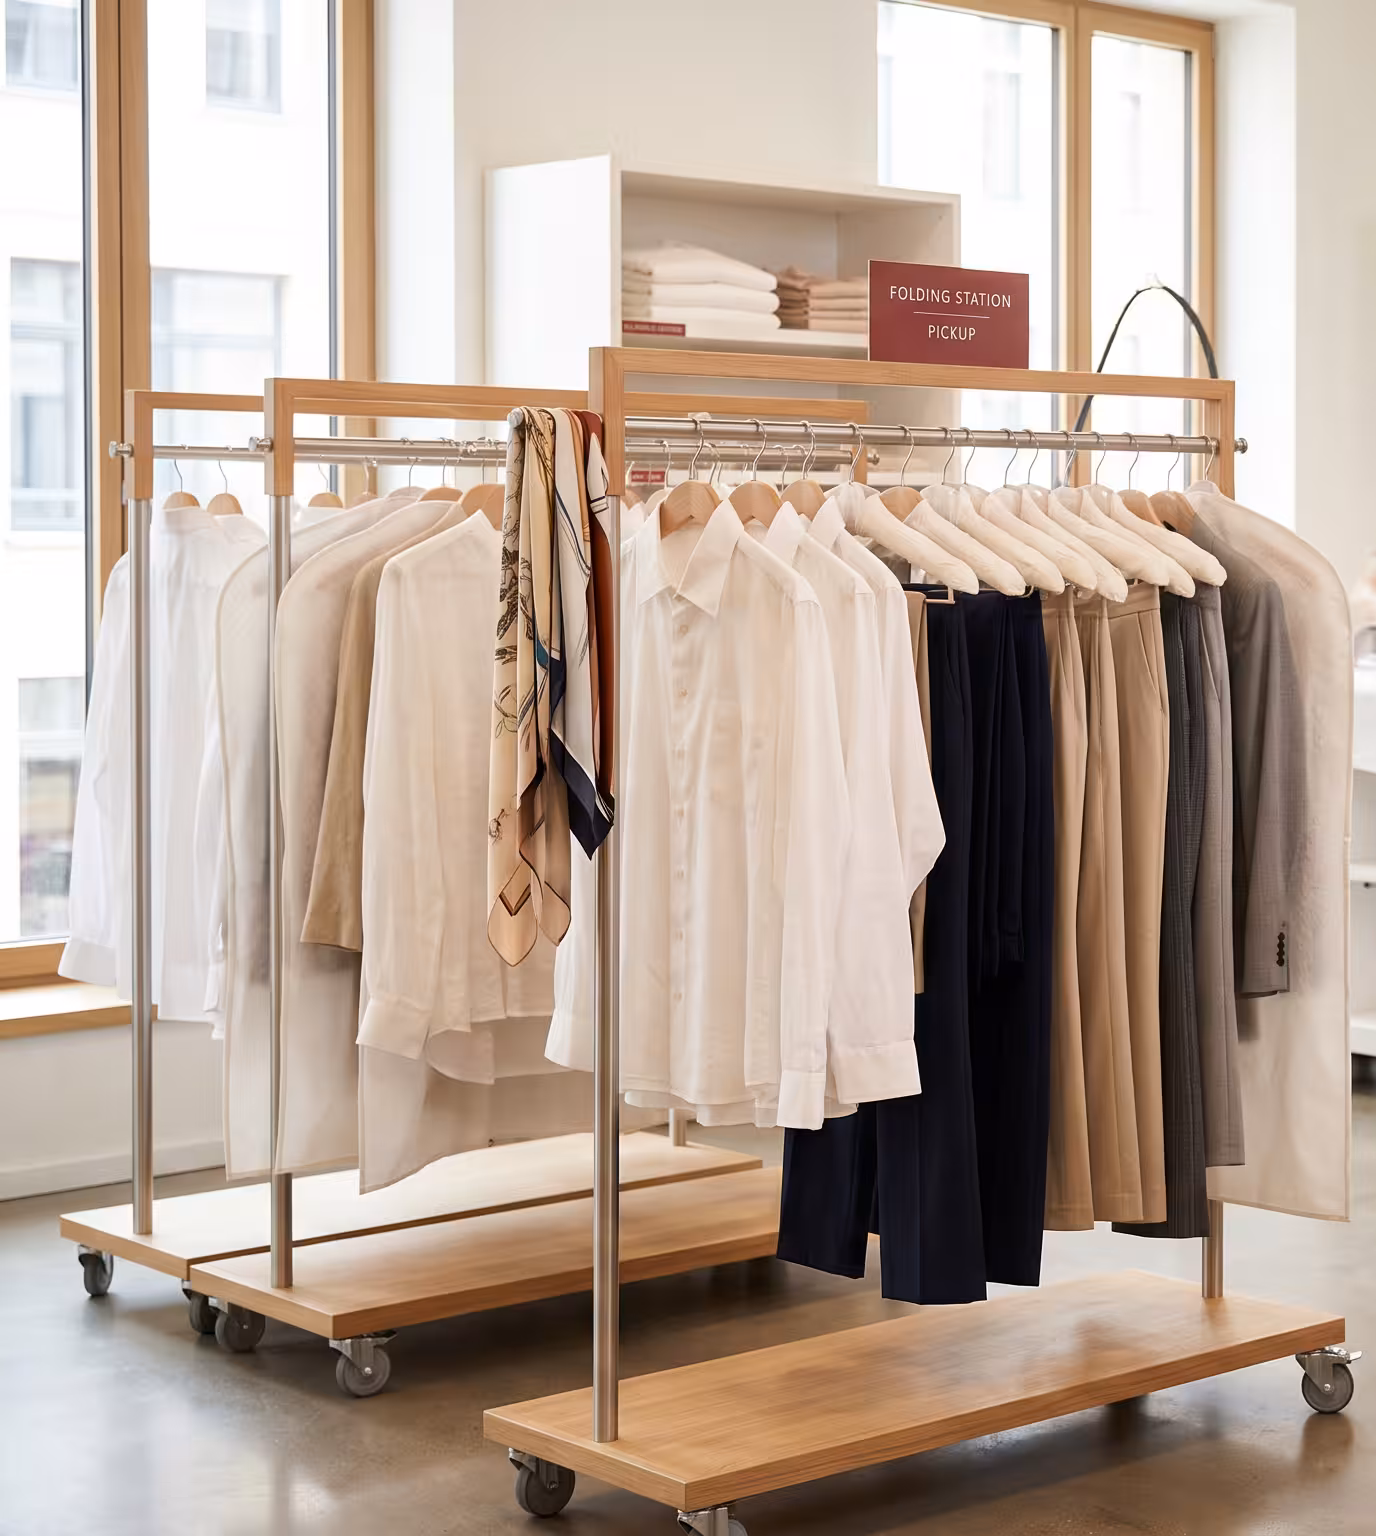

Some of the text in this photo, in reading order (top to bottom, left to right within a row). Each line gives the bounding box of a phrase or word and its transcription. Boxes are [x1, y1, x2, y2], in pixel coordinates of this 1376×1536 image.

[890, 286, 1011, 308] FOLDING STATION
[928, 325, 976, 341] PICKUP
